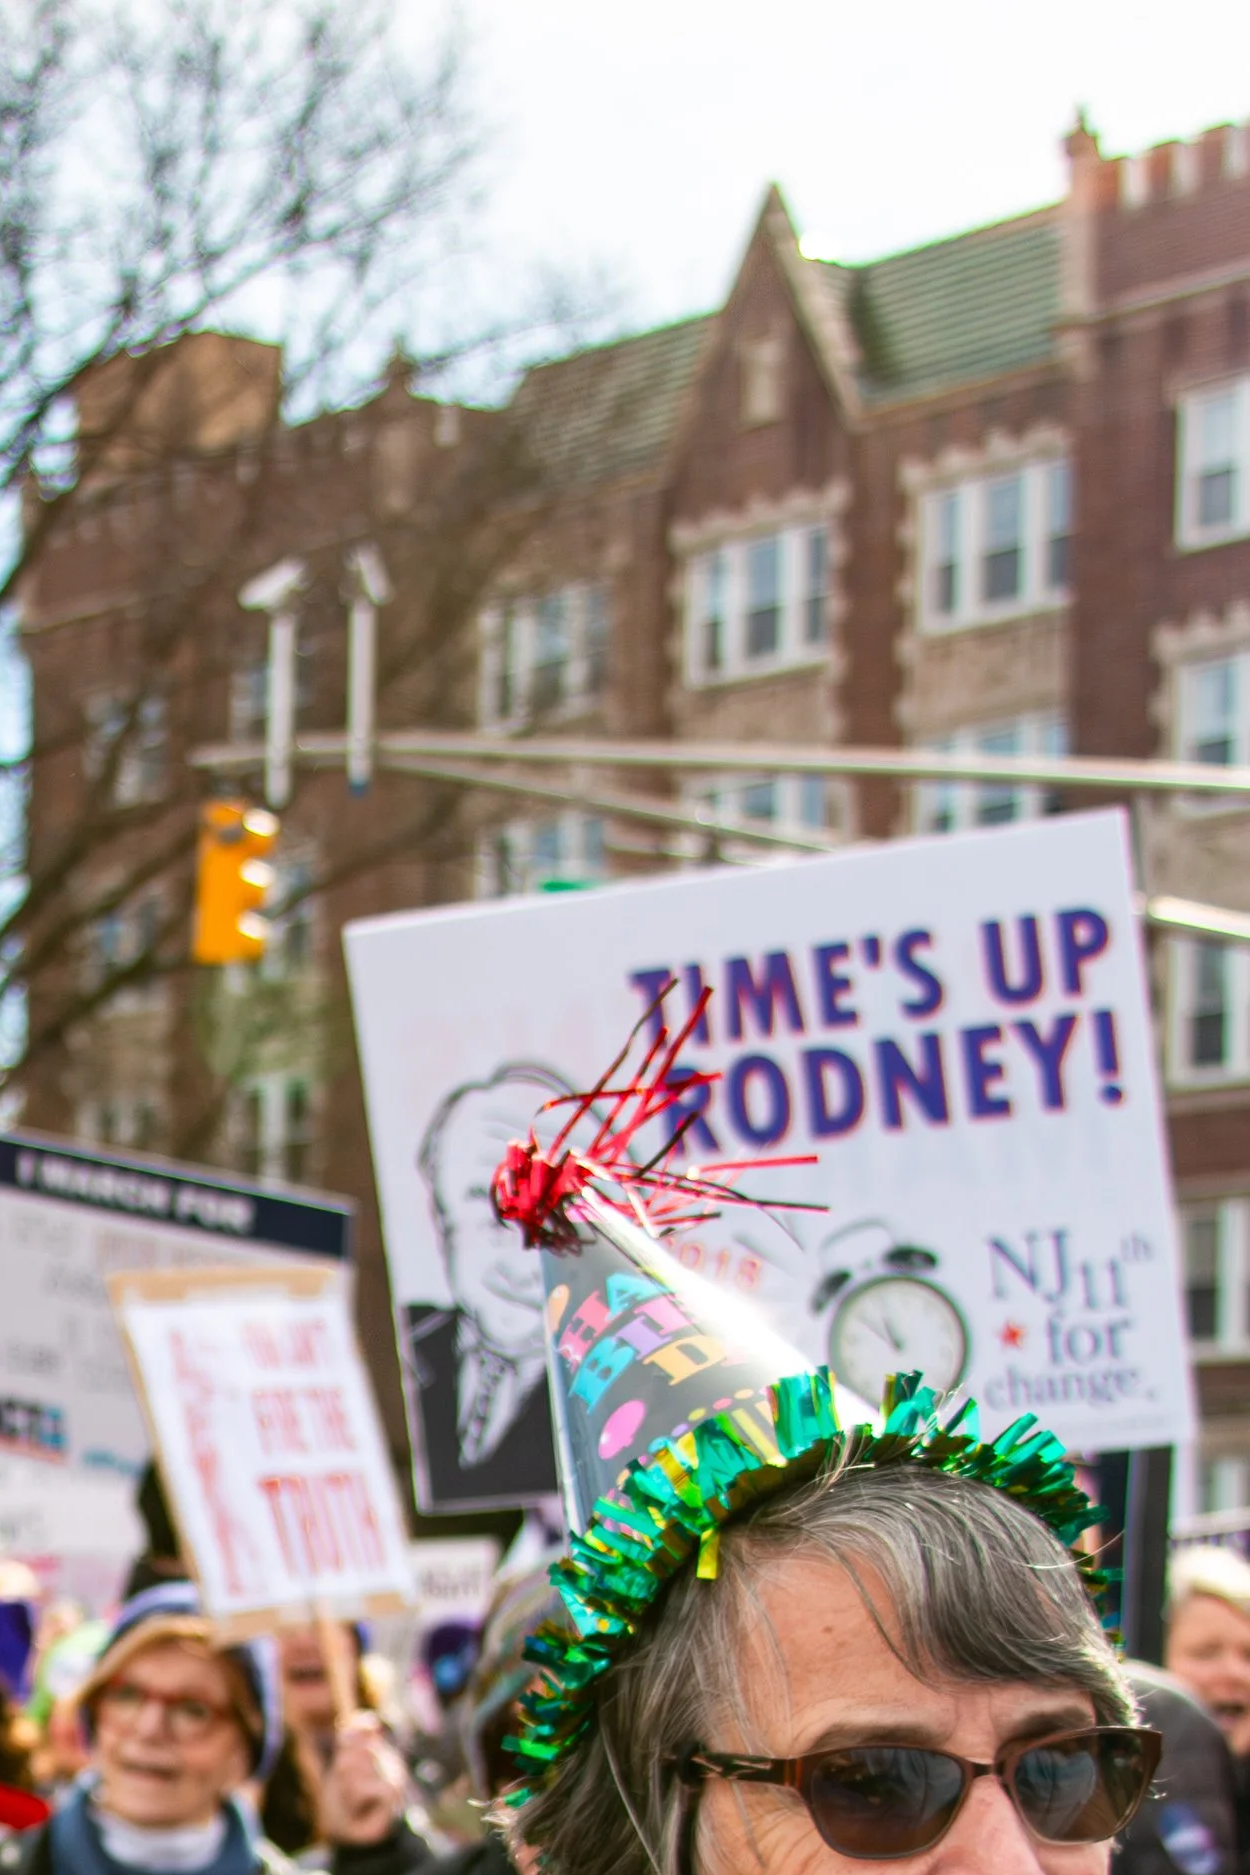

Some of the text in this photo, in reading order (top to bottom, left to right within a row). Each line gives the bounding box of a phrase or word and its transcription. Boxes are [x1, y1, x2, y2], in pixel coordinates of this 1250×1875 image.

[629, 909, 1109, 1049] TIME'S UP
[662, 1009, 1124, 1156] RODNEY!
[1047, 1308, 1133, 1368] for
